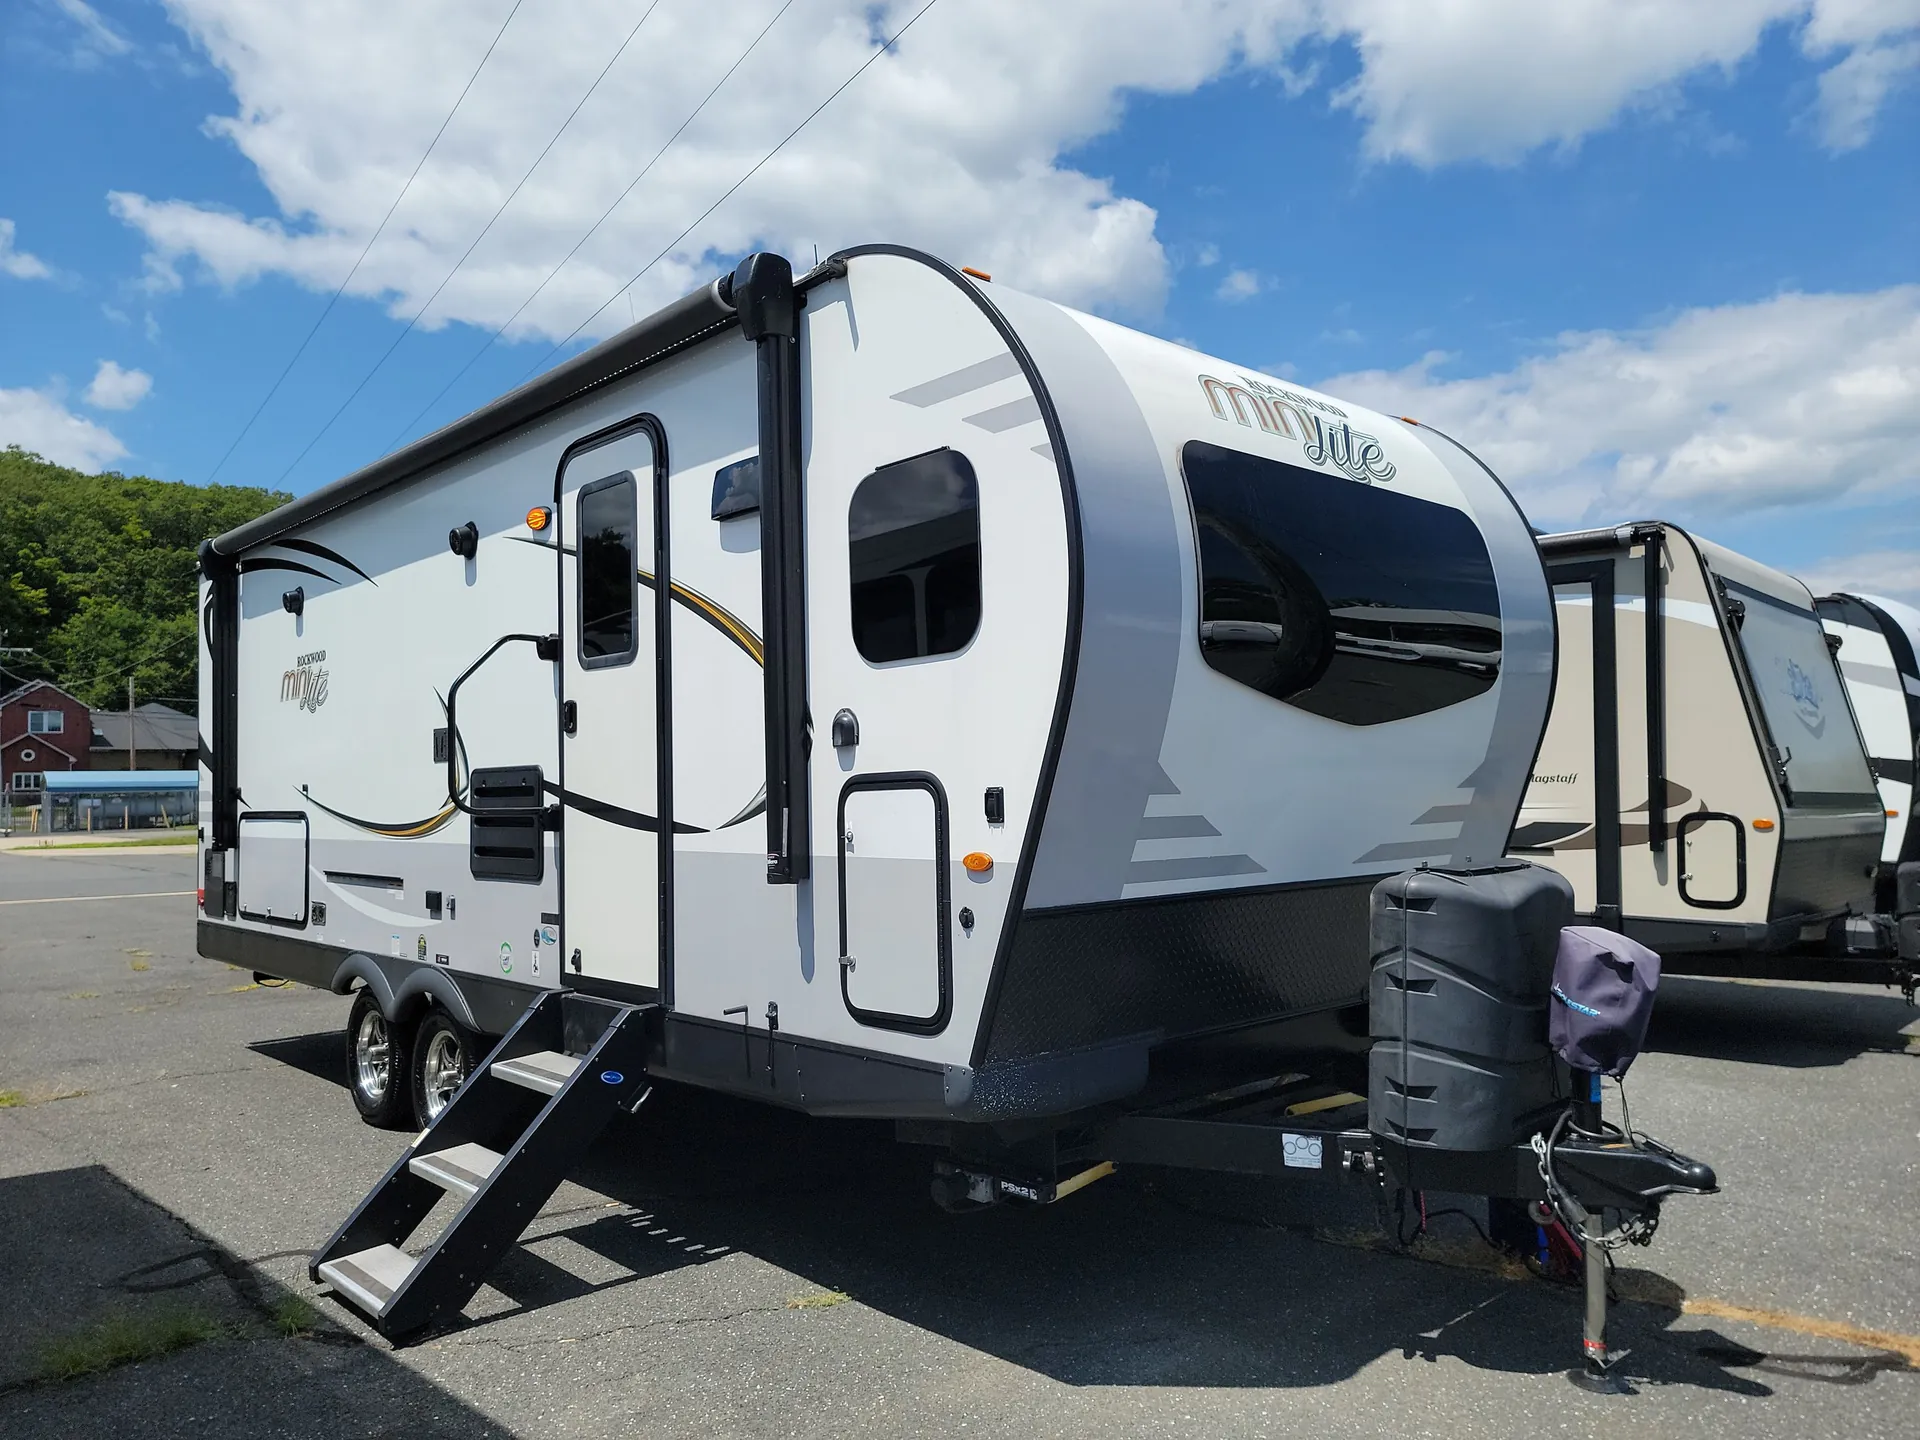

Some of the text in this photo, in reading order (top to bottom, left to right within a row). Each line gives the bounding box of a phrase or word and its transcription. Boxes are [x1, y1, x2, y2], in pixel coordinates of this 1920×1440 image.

[1237, 374, 1348, 418] ROCKWOOD
[297, 650, 327, 667] ROCKWOOD
[1531, 773, 1578, 784] lagstaff
